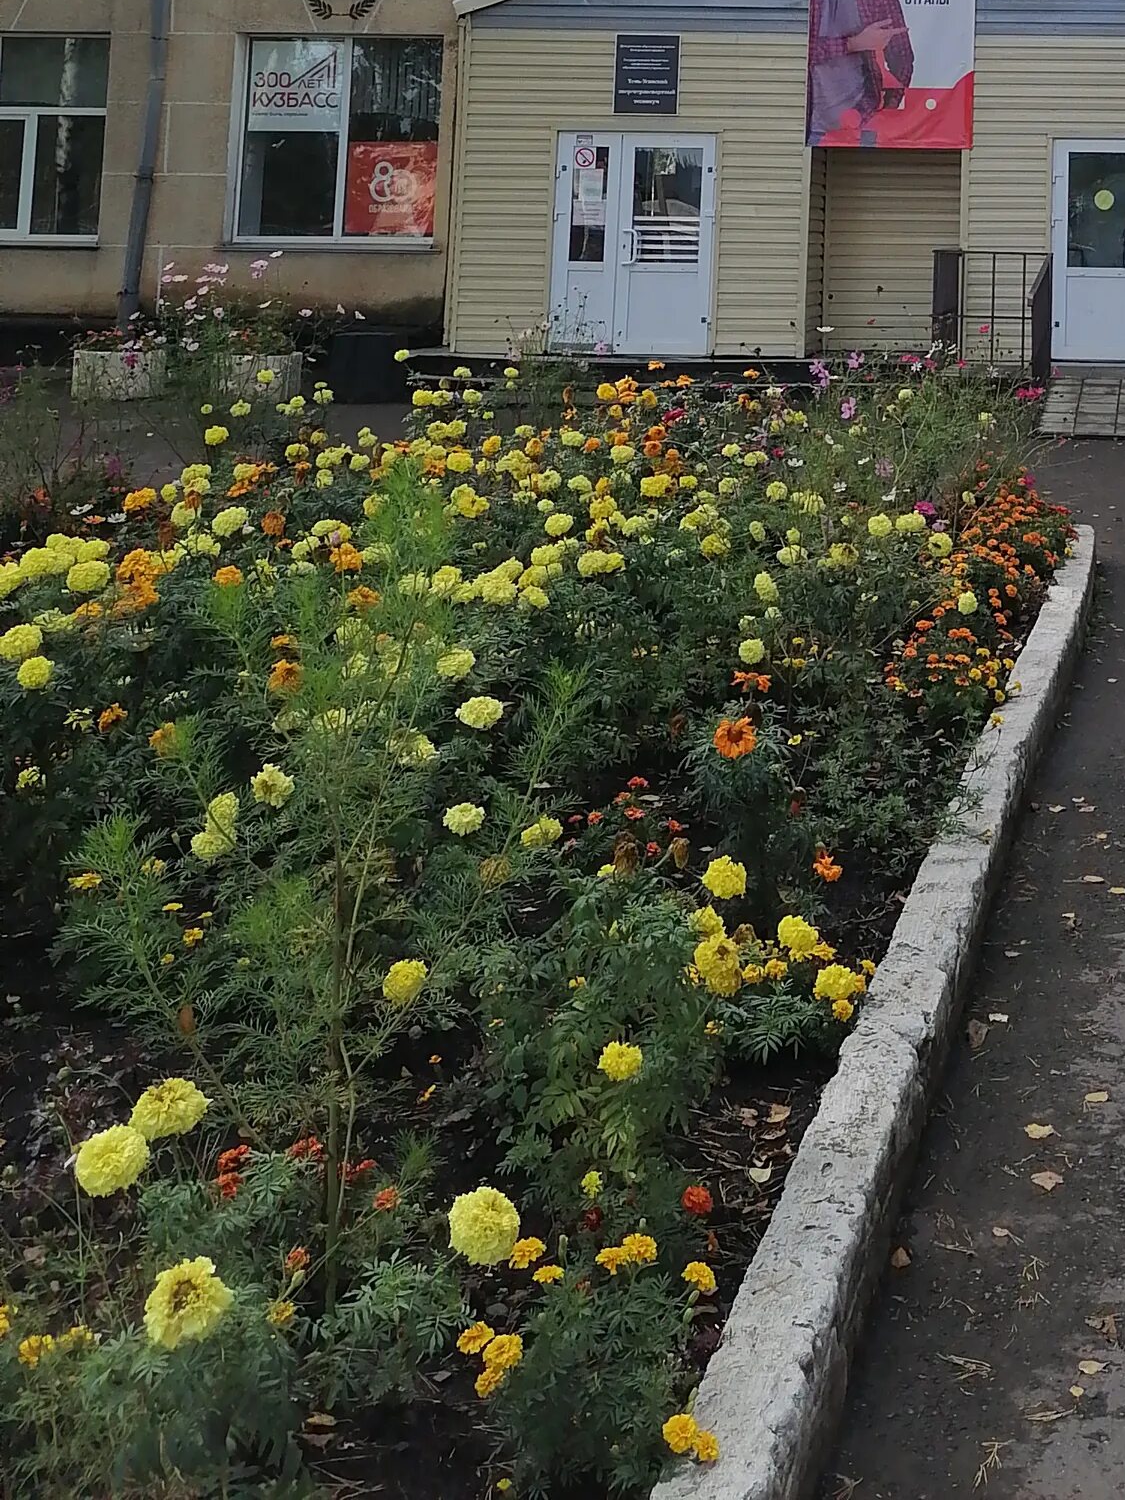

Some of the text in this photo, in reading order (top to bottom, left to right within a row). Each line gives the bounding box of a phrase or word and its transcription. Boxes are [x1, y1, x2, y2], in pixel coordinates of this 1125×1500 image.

[254, 71, 325, 89] 300 ЛЕТ
[252, 91, 339, 108] КУЗБАСС
